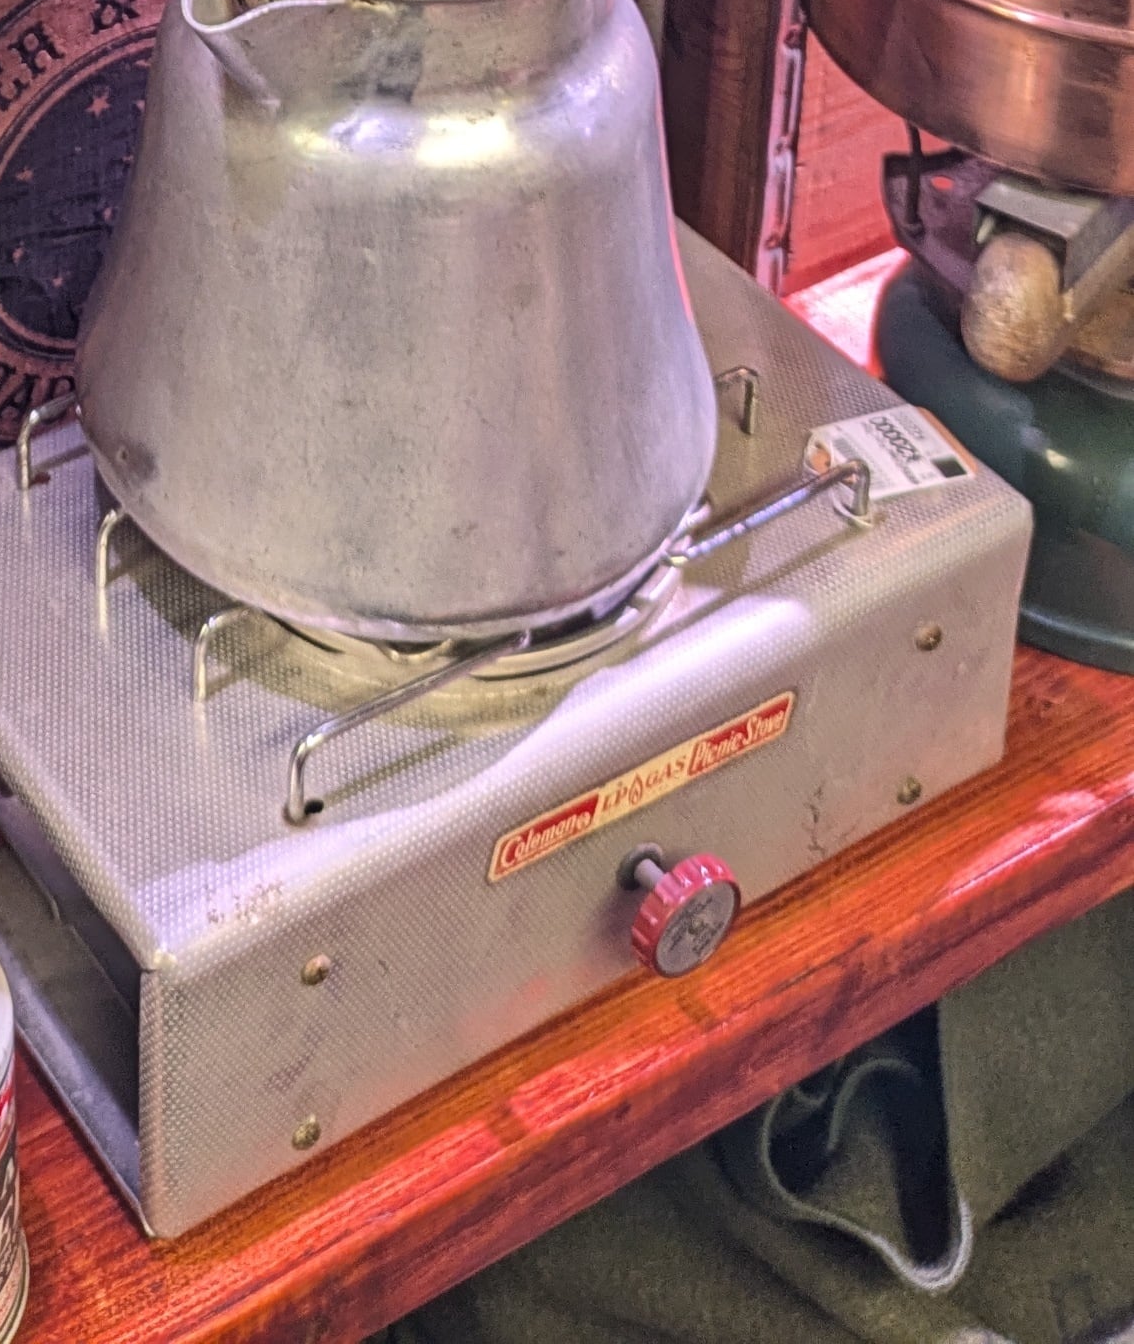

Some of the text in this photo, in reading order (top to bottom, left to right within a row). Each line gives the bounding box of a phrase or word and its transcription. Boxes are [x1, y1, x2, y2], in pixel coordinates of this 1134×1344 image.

[500, 813, 581, 868] Coleman
[645, 756, 686, 788] GAS
[691, 729, 745, 773] Picnic
[744, 710, 786, 745] Stove
